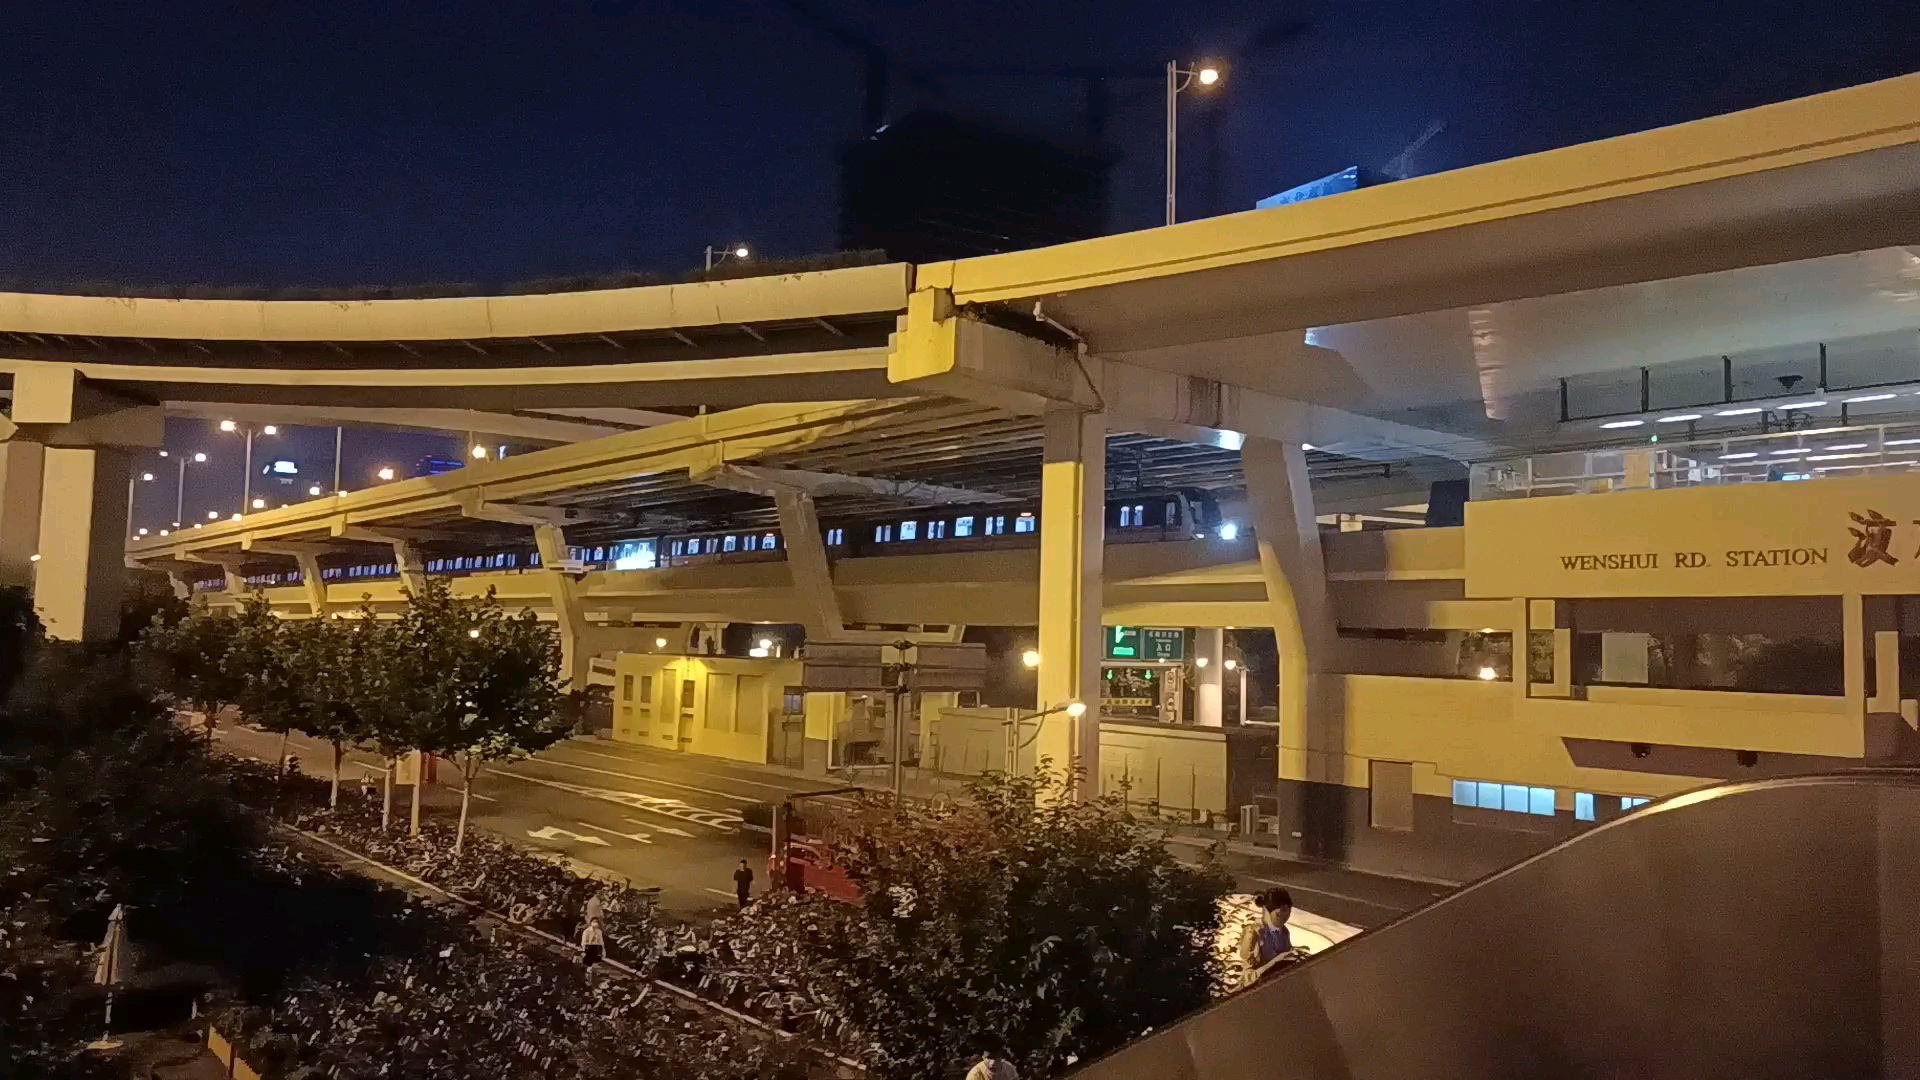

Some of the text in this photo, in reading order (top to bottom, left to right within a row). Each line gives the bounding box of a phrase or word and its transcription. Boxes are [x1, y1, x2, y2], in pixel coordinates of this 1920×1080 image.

[1847, 508, 1920, 568] 汶
[1560, 548, 1828, 570] WENSHUI RD. STATION
